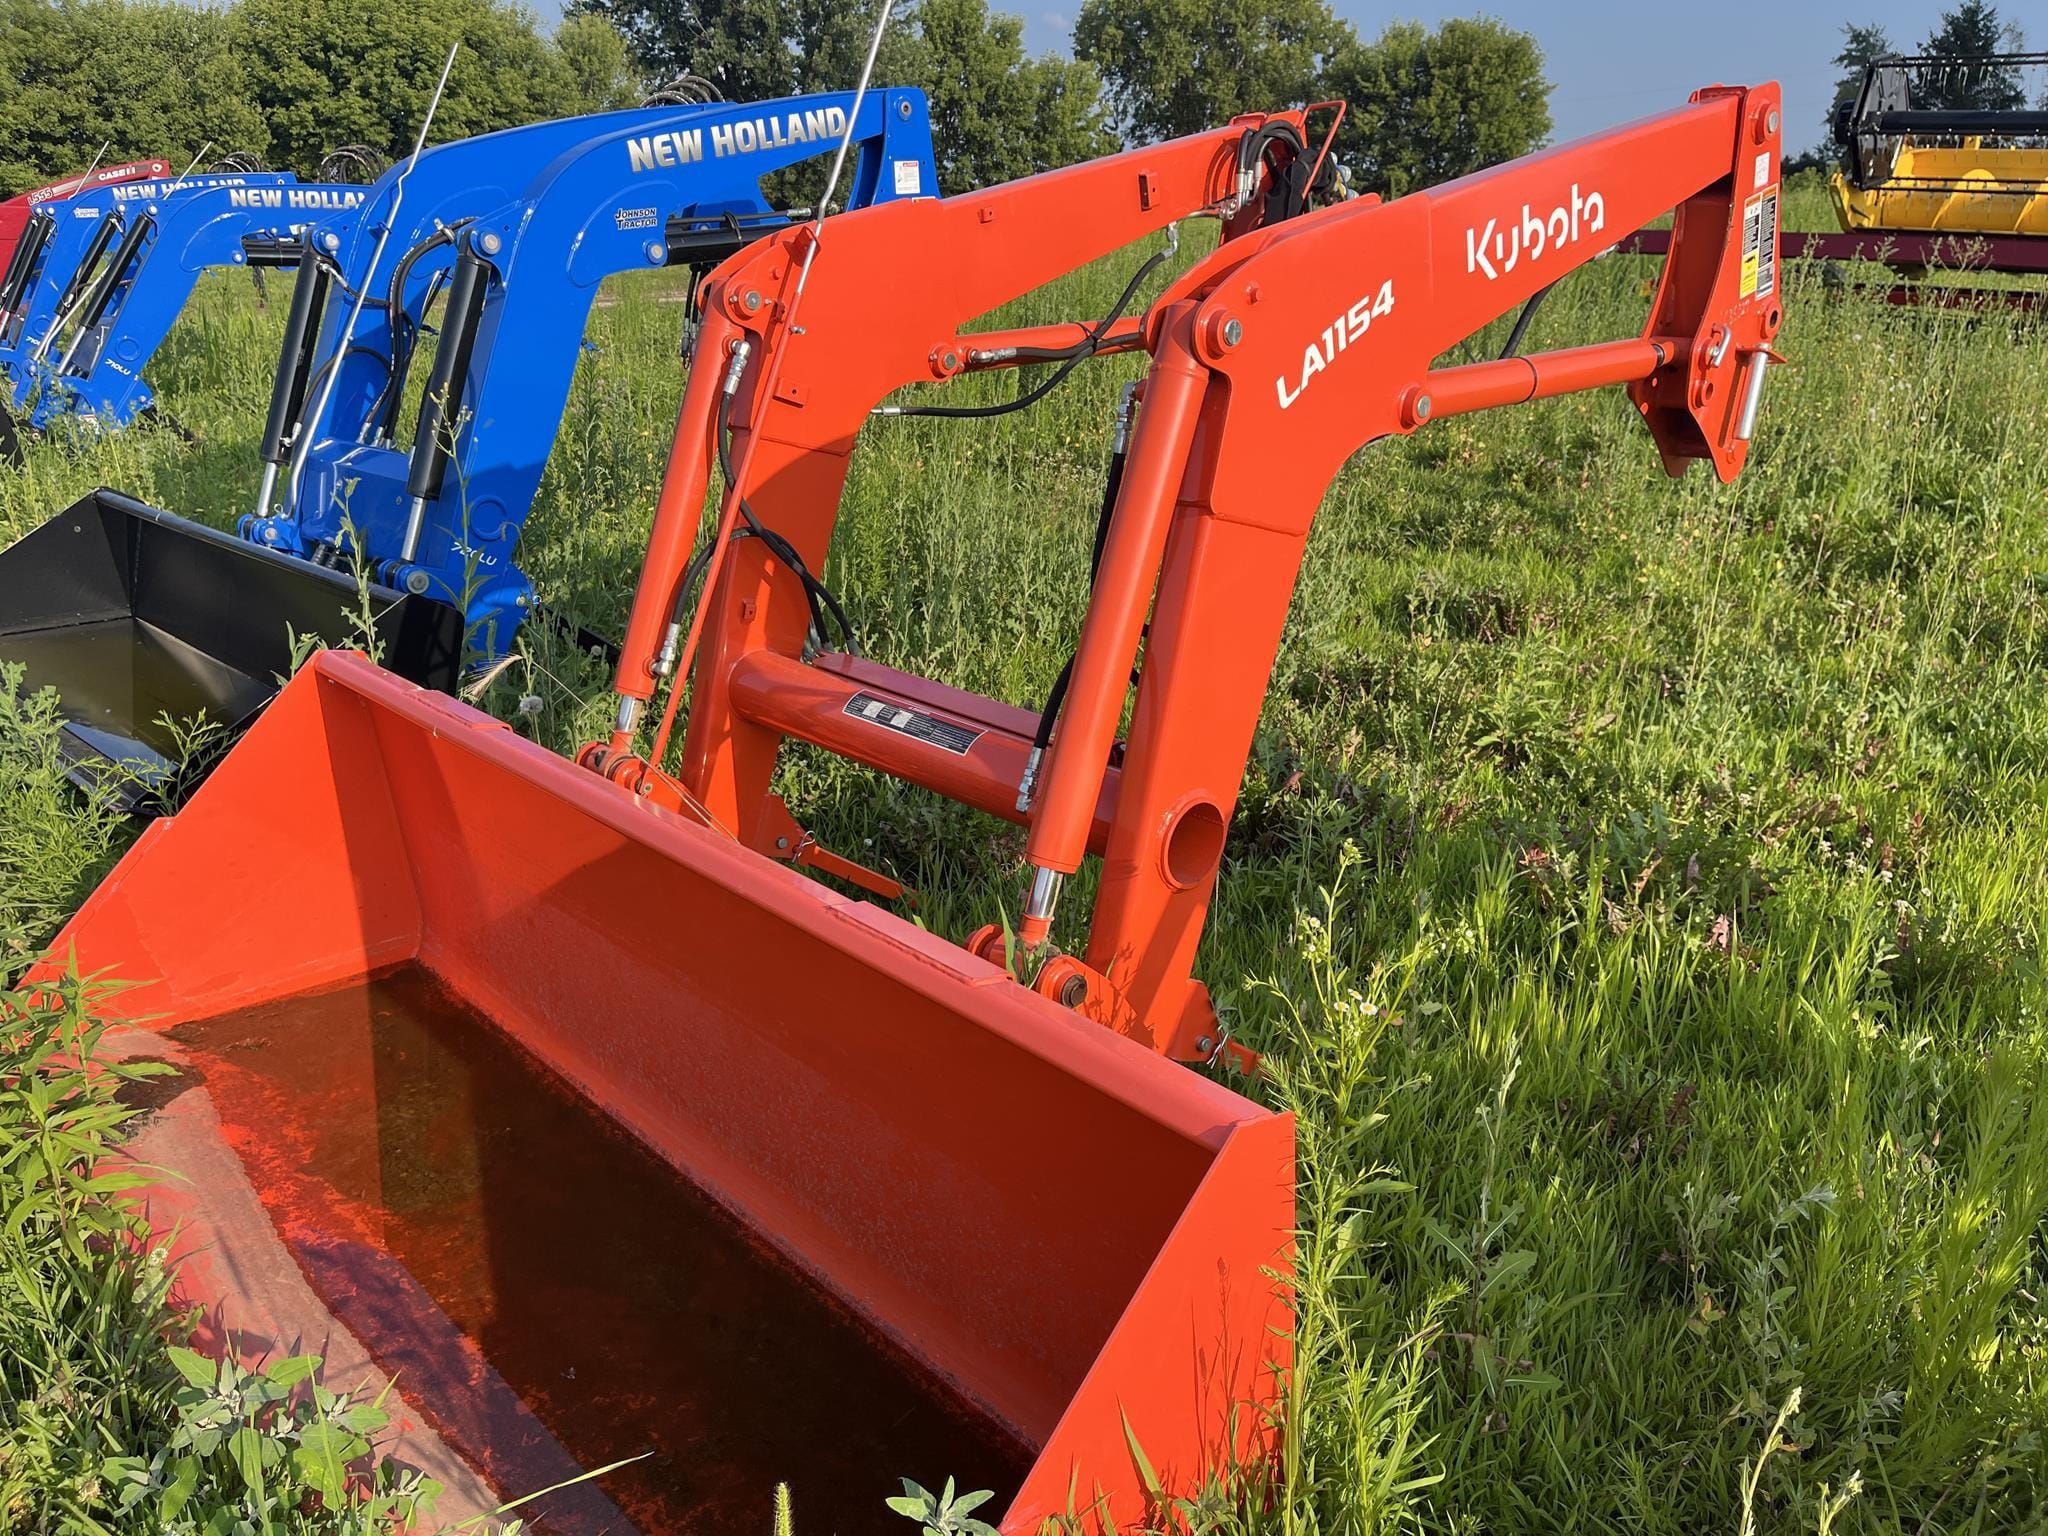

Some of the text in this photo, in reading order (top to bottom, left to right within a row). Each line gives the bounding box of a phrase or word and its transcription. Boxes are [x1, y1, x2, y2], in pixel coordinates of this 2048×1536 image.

[627, 106, 847, 173] NEW HOLLAND
[98, 168, 126, 181] CASE
[112, 184, 156, 201] NEW
[229, 189, 365, 210] NEW HOLLA
[614, 207, 657, 220] JOHNSON
[615, 217, 658, 231] TRACTOR
[1466, 183, 1605, 281] Kubota
[1276, 278, 1396, 410] LA1154
[105, 358, 131, 376] 710LU
